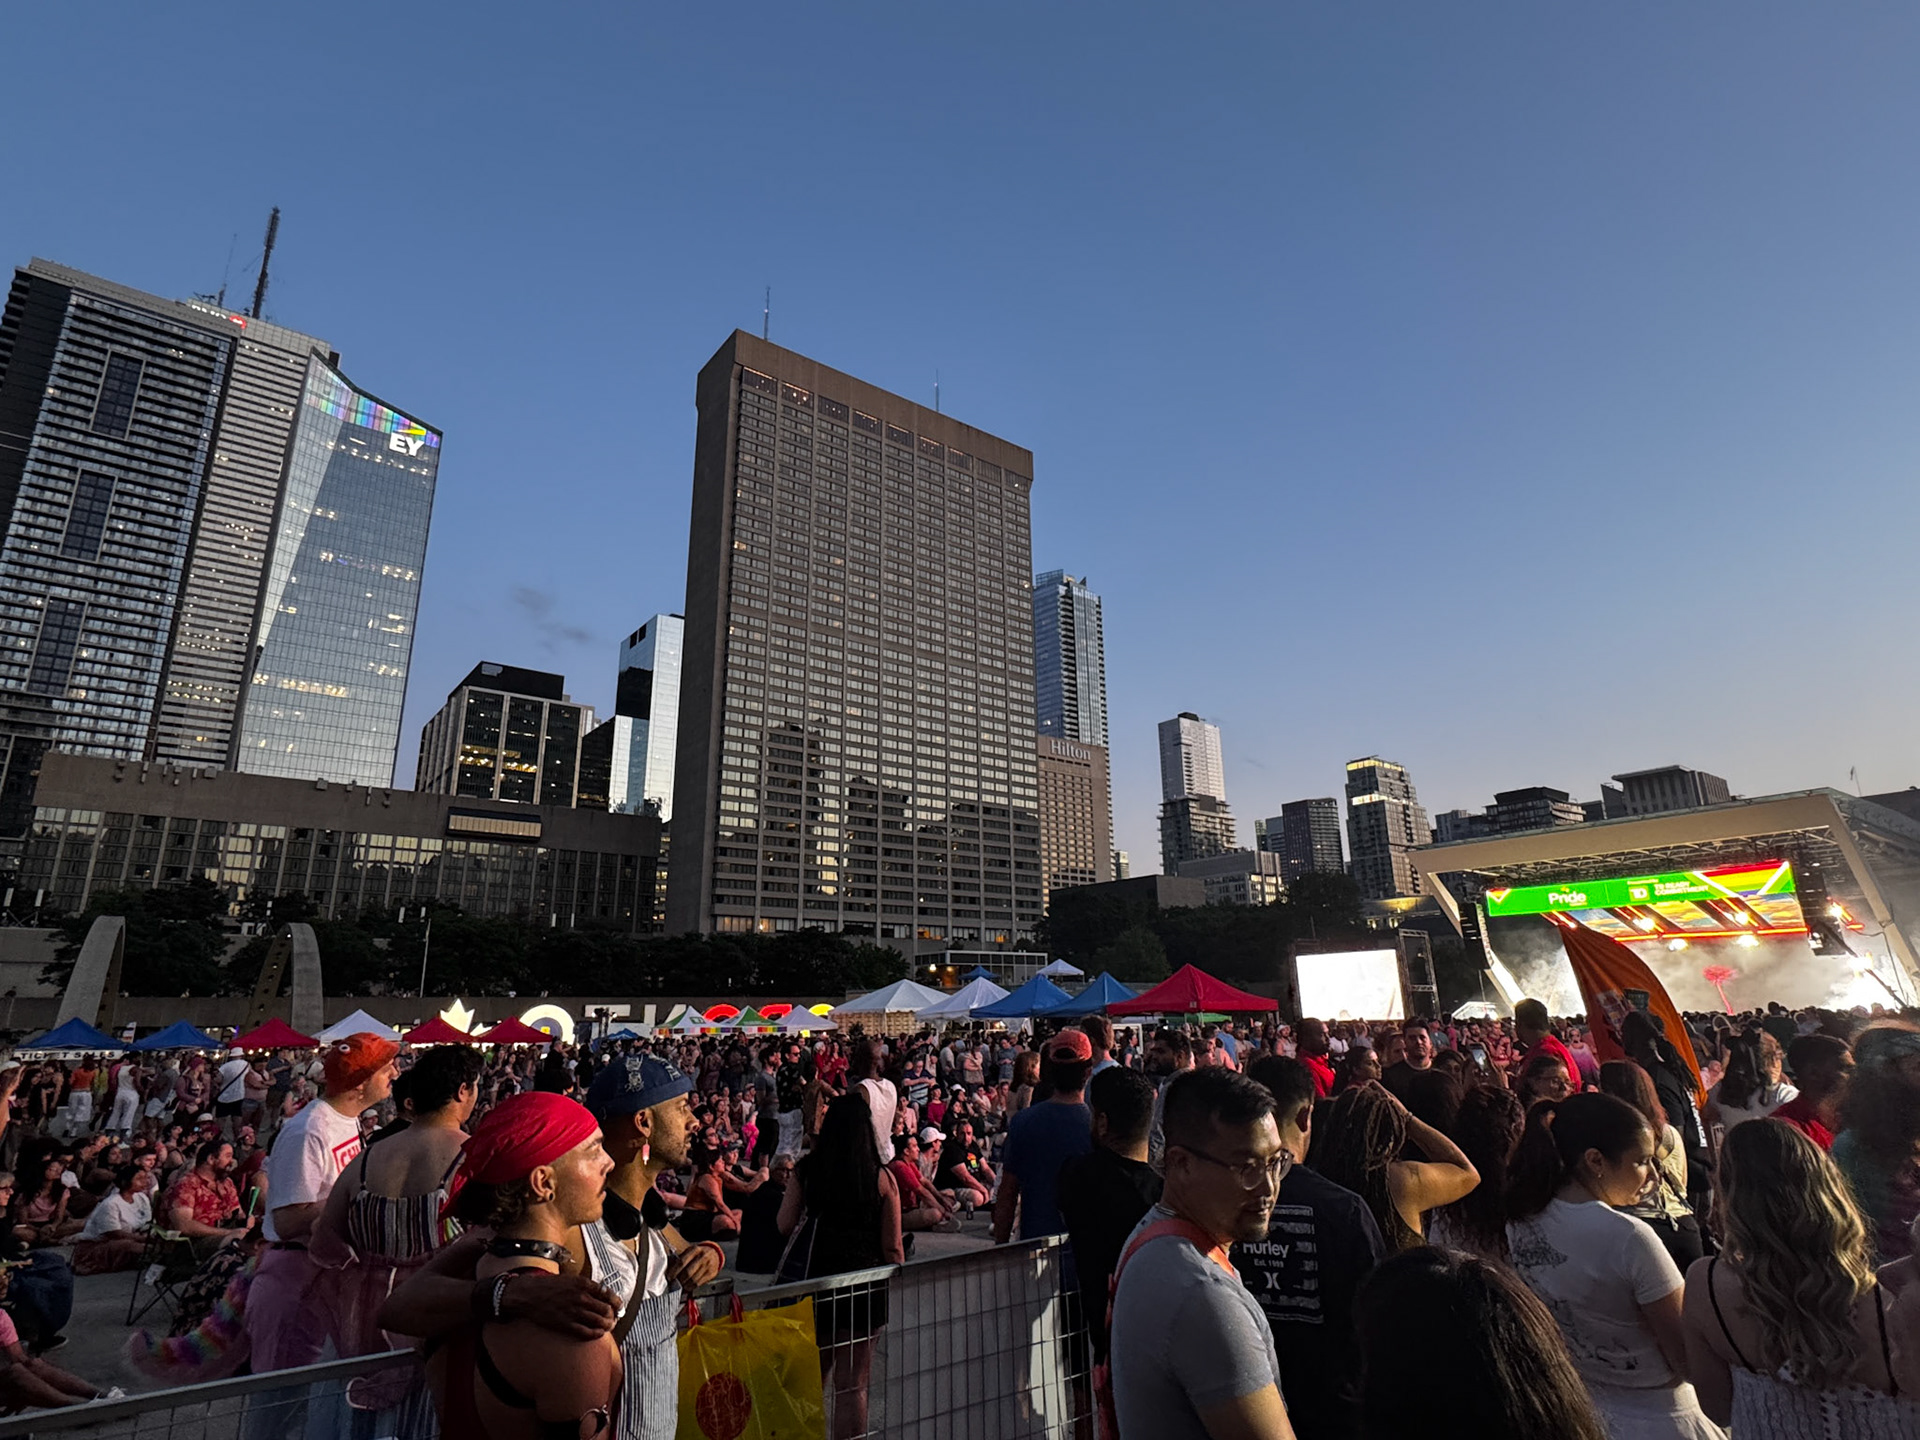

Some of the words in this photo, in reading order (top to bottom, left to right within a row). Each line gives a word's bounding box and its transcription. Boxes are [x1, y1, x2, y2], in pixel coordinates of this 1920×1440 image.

[389, 432, 425, 457] EY
[1051, 740, 1091, 760] Hilton
[1548, 891, 1587, 905] Pride
[21, 1051, 71, 1060] TICKT
[1242, 1239, 1290, 1259] Hurley
